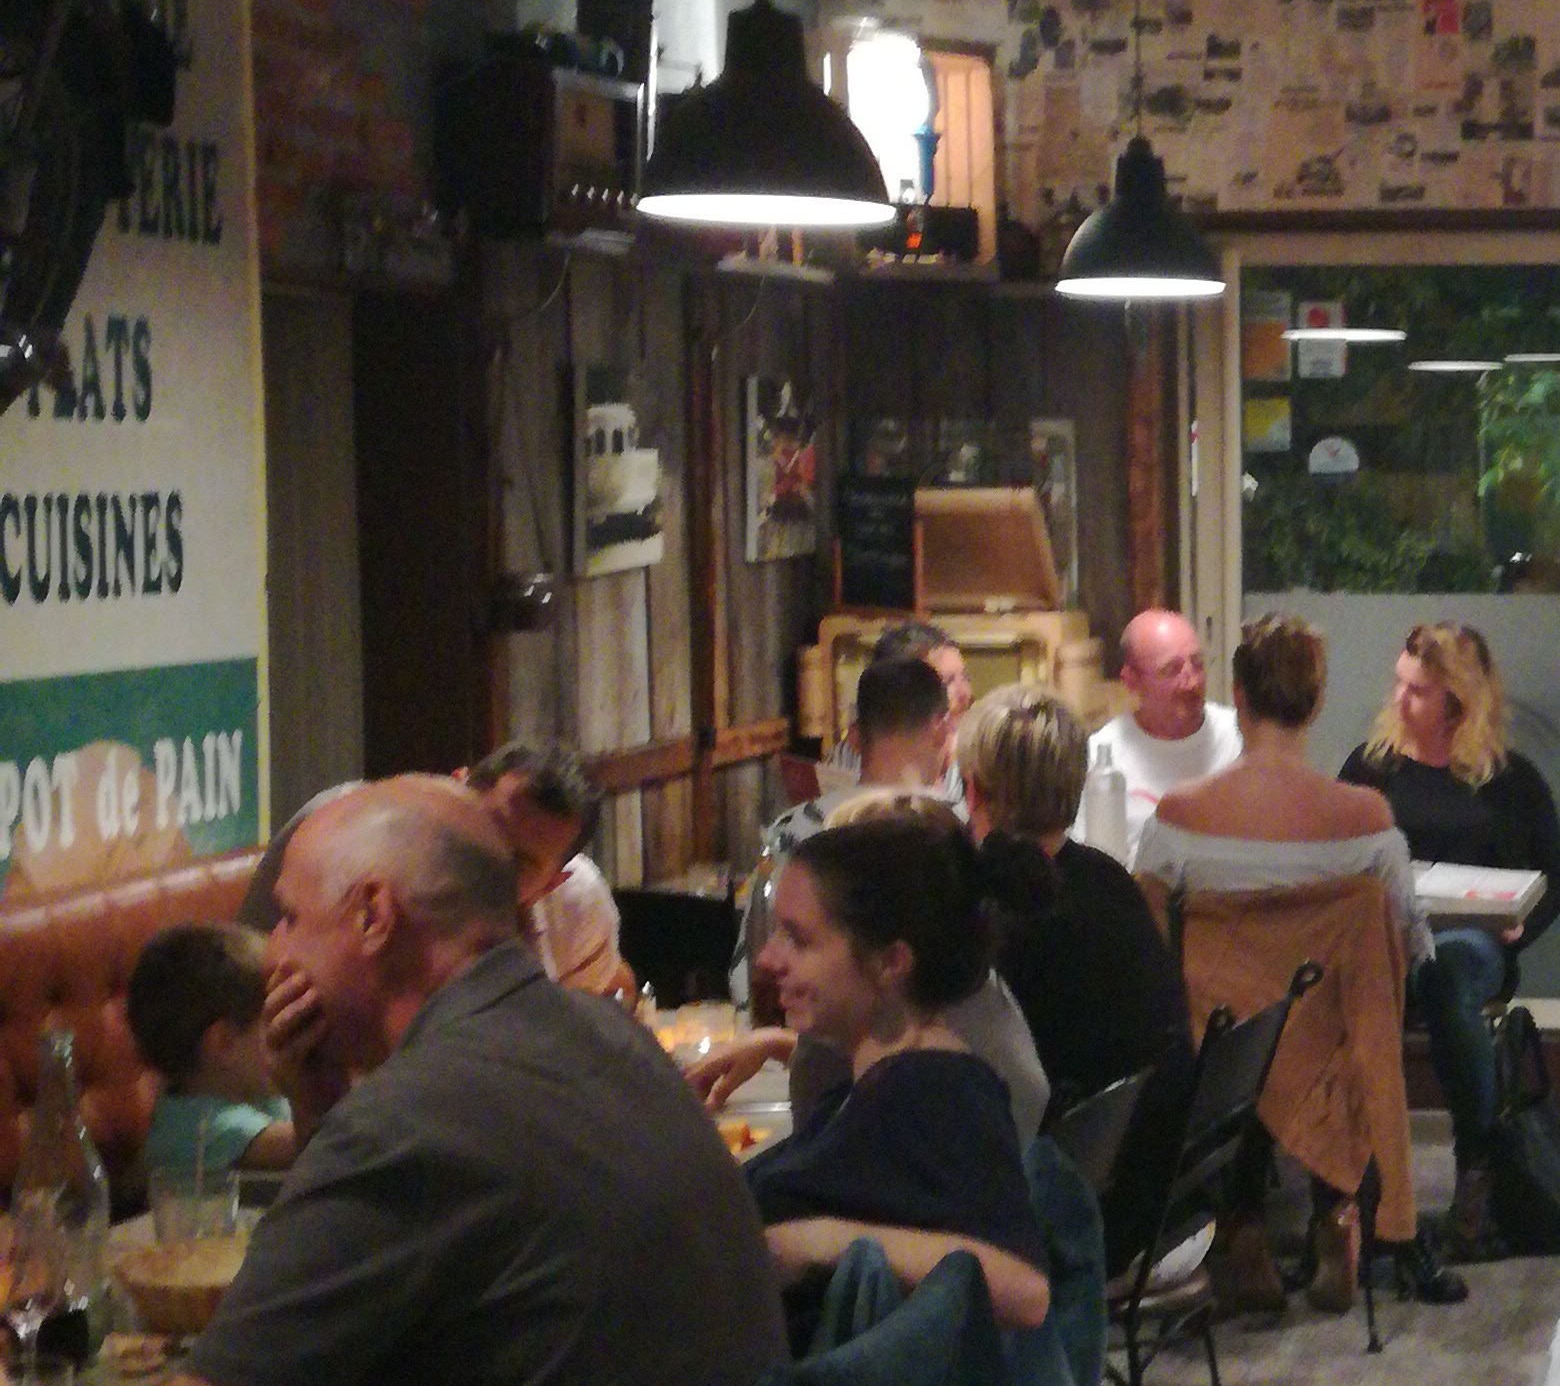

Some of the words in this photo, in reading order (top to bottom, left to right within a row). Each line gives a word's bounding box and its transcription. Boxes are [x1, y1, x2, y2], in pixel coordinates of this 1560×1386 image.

[0, 489, 183, 606] CUISINES
[96, 746, 140, 843] de
[152, 728, 243, 831] PAIN
